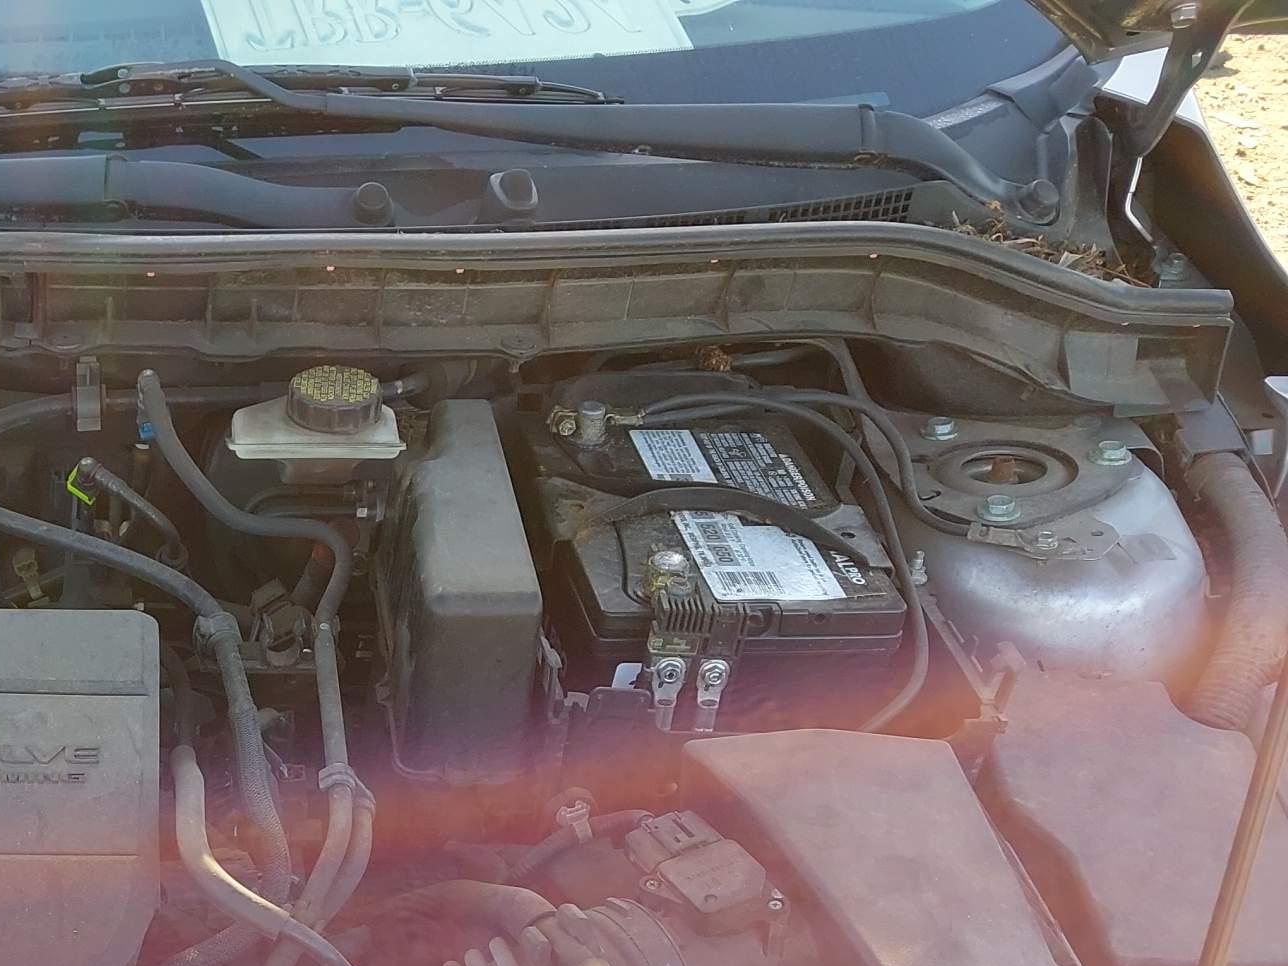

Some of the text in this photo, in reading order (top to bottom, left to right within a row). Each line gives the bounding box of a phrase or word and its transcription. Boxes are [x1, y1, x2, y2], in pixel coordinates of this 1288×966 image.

[795, 479, 816, 500] POISON
[700, 523, 721, 540] 520
[713, 546, 734, 563] 650
